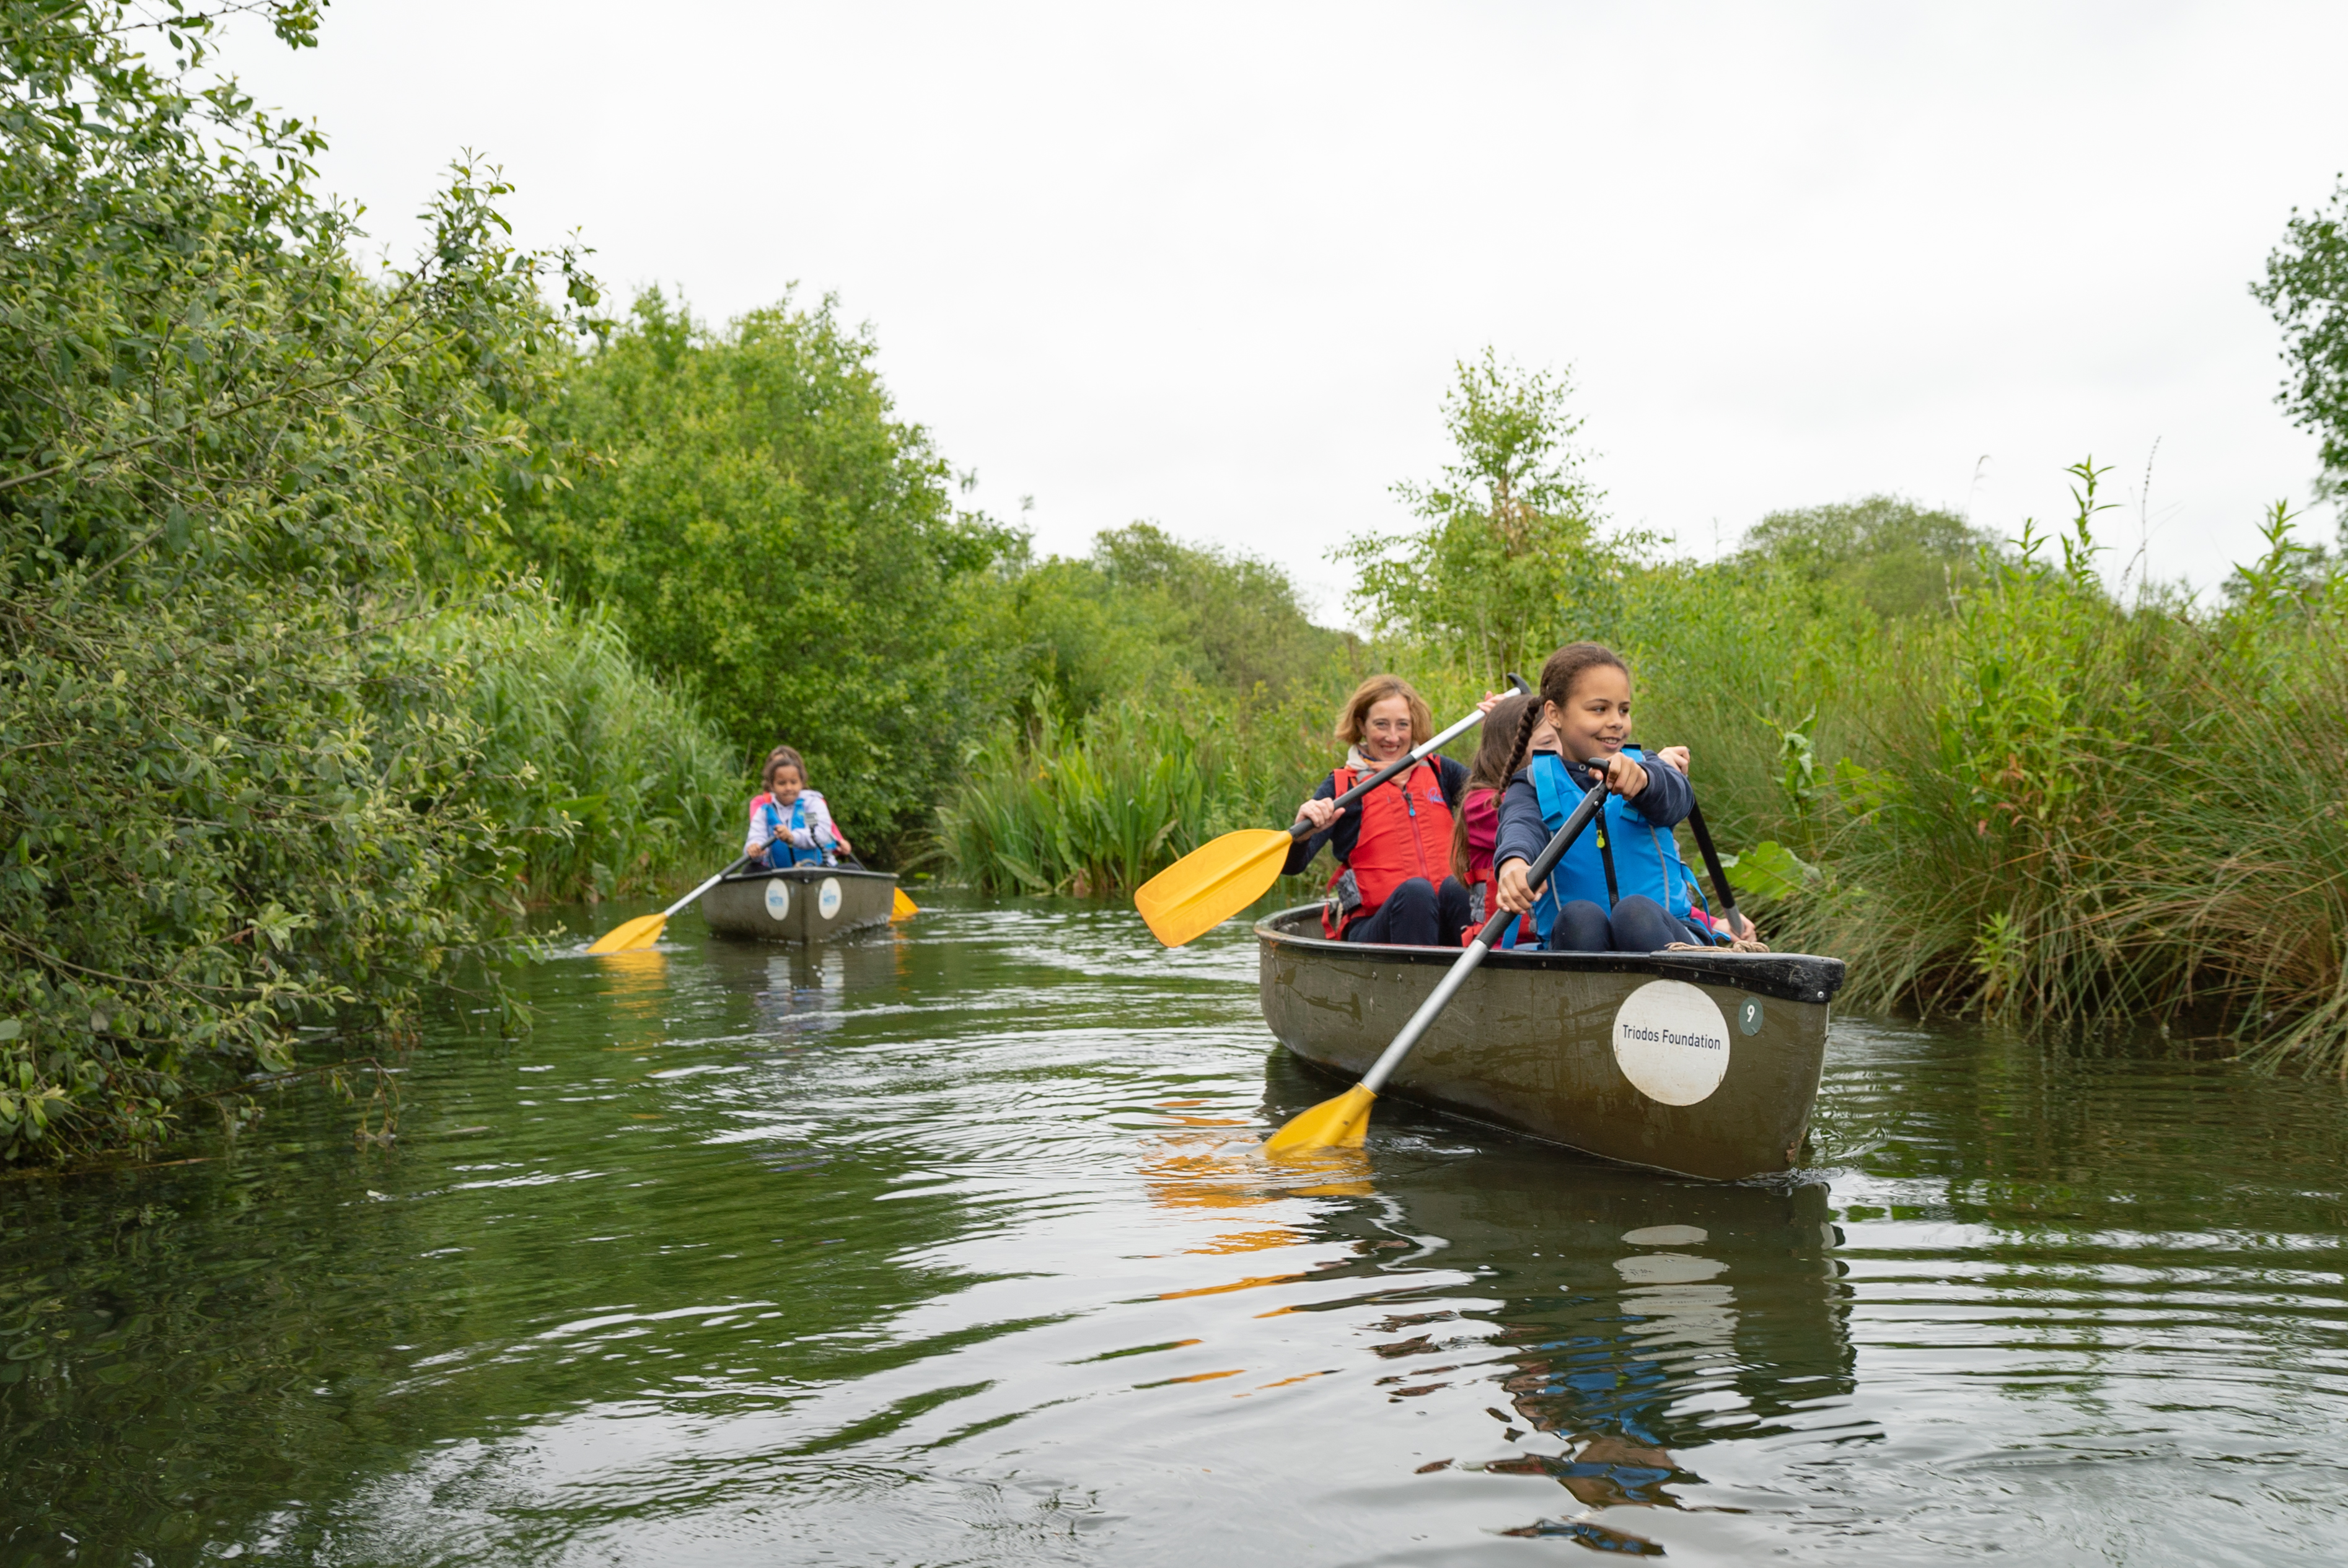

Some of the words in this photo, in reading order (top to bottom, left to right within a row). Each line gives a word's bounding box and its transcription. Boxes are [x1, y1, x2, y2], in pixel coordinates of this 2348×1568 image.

[1747, 1005, 1755, 1022] 9
[1623, 1024, 1659, 1042] Triodos
[1662, 1029, 1720, 1050] Foundation
